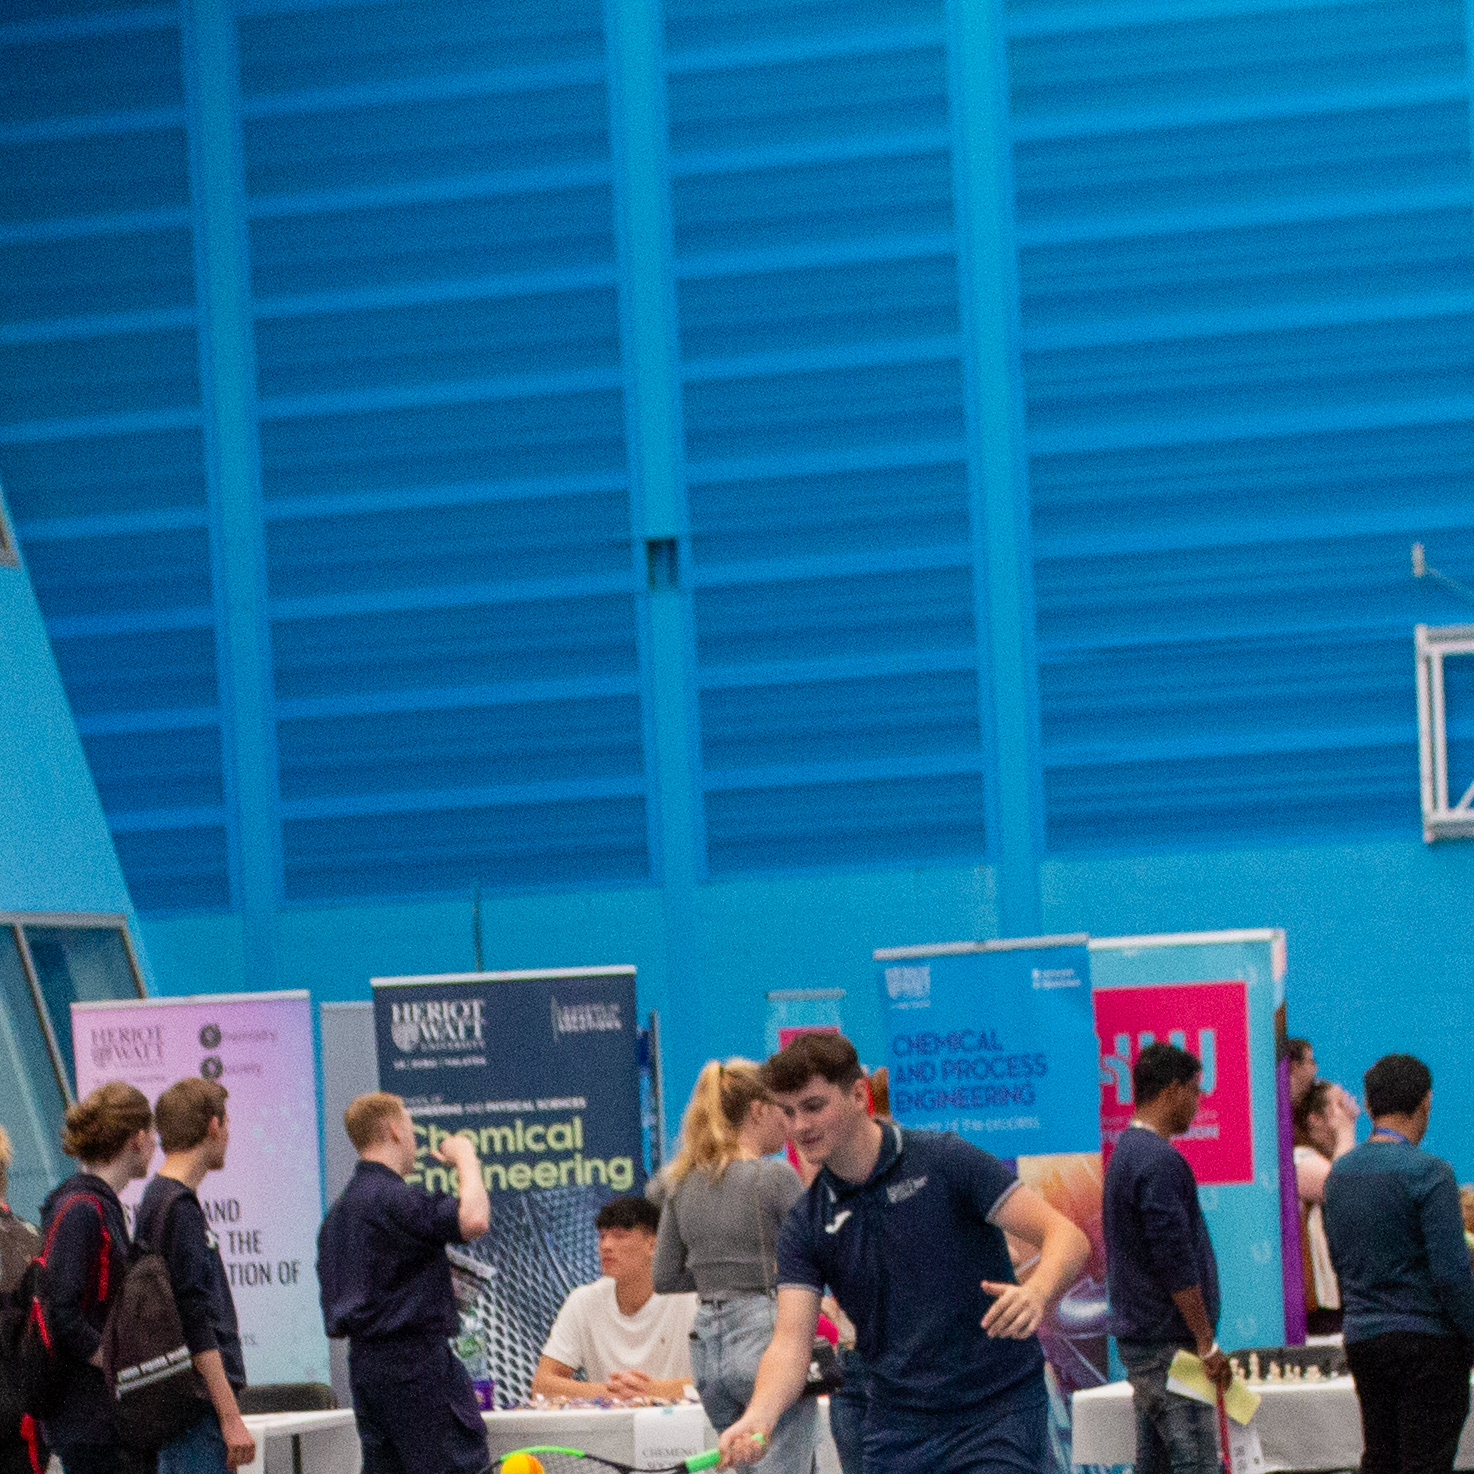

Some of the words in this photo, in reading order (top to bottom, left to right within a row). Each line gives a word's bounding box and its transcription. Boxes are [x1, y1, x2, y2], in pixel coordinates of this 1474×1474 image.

[392, 999, 485, 1023] HERIOT
[91, 1023, 163, 1046] HERIOT
[419, 1019, 483, 1041] WATT
[892, 1029, 1003, 1057] CHEMICAL
[895, 1058, 936, 1085] AND
[941, 1053, 1049, 1081] PROCESS
[895, 1081, 1036, 1113] ENGINEERING
[413, 1116, 584, 1157] Chemical
[406, 1152, 634, 1195] Engneering
[228, 1230, 262, 1254] THE
[227, 1262, 273, 1287] TION
[278, 1259, 301, 1286] OF
